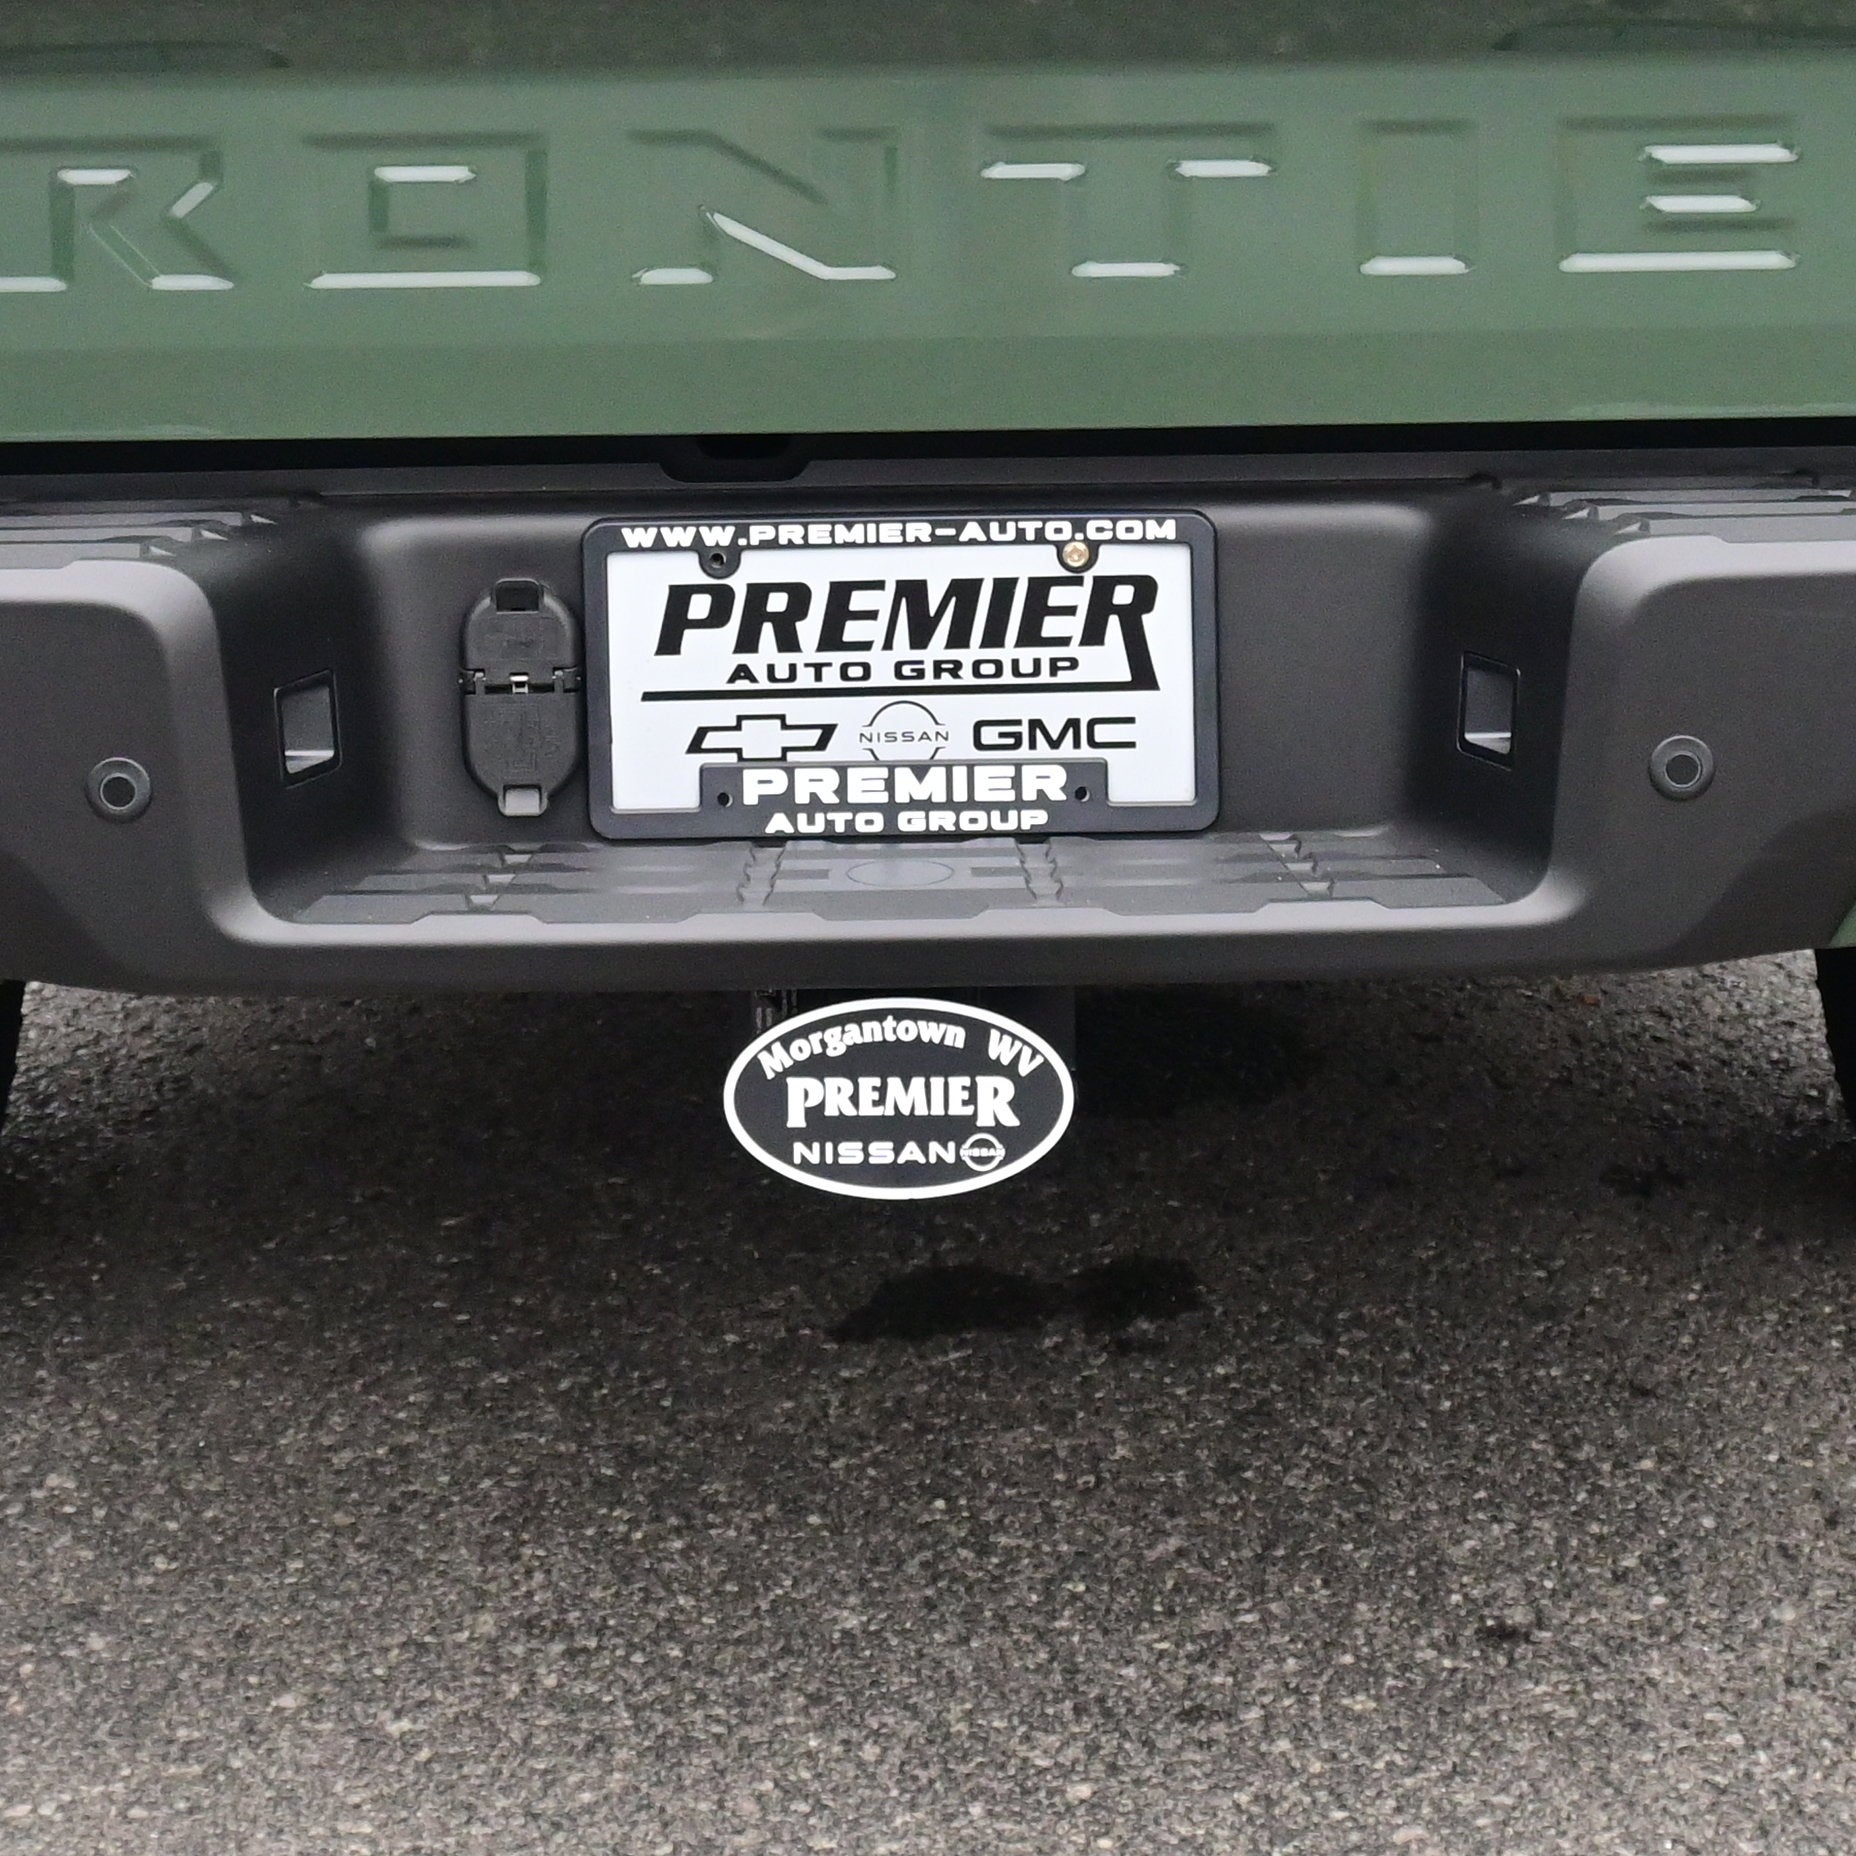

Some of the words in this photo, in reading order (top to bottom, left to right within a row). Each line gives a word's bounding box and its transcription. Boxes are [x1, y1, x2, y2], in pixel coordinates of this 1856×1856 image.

[621, 519, 1178, 548] WWW.PREMIER-AUTO.COM
[654, 574, 1161, 691] PREMIER
[726, 660, 872, 684] AUTO
[893, 656, 1081, 682] GROUP
[858, 729, 950, 744] NISSAN
[972, 716, 1137, 751] GMC
[743, 764, 1068, 806] PREMIER
[764, 812, 885, 834] AUTO
[897, 809, 1049, 833] GROUP
[756, 1015, 967, 1081] Morgantown
[987, 1028, 1045, 1078] WV
[785, 1075, 1021, 1129] PREMIER
[792, 1140, 957, 1165] NISSAN
[960, 1147, 1006, 1158] NISSAN
